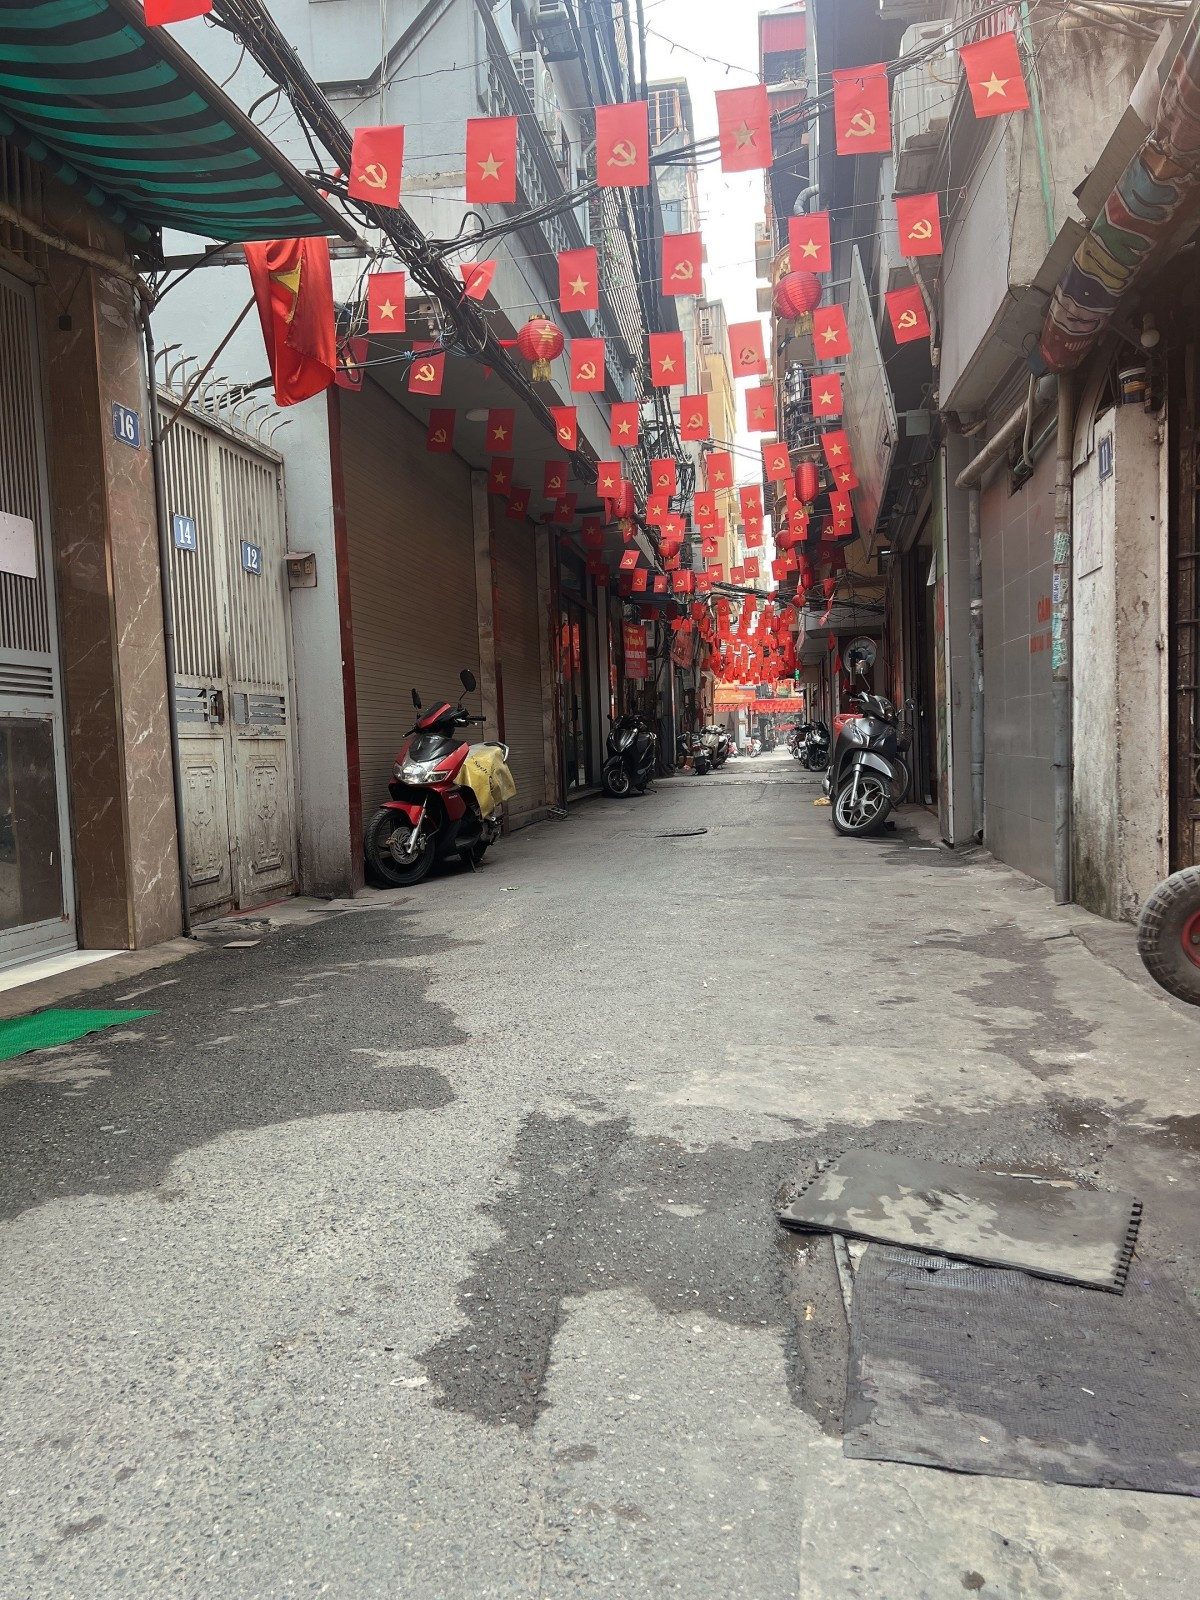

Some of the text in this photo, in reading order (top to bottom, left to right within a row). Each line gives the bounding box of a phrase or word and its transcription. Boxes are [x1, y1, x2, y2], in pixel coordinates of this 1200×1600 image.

[119, 410, 135, 440] 16
[1101, 441, 1108, 473] 11
[178, 520, 192, 544] 14
[246, 546, 258, 569] 12
